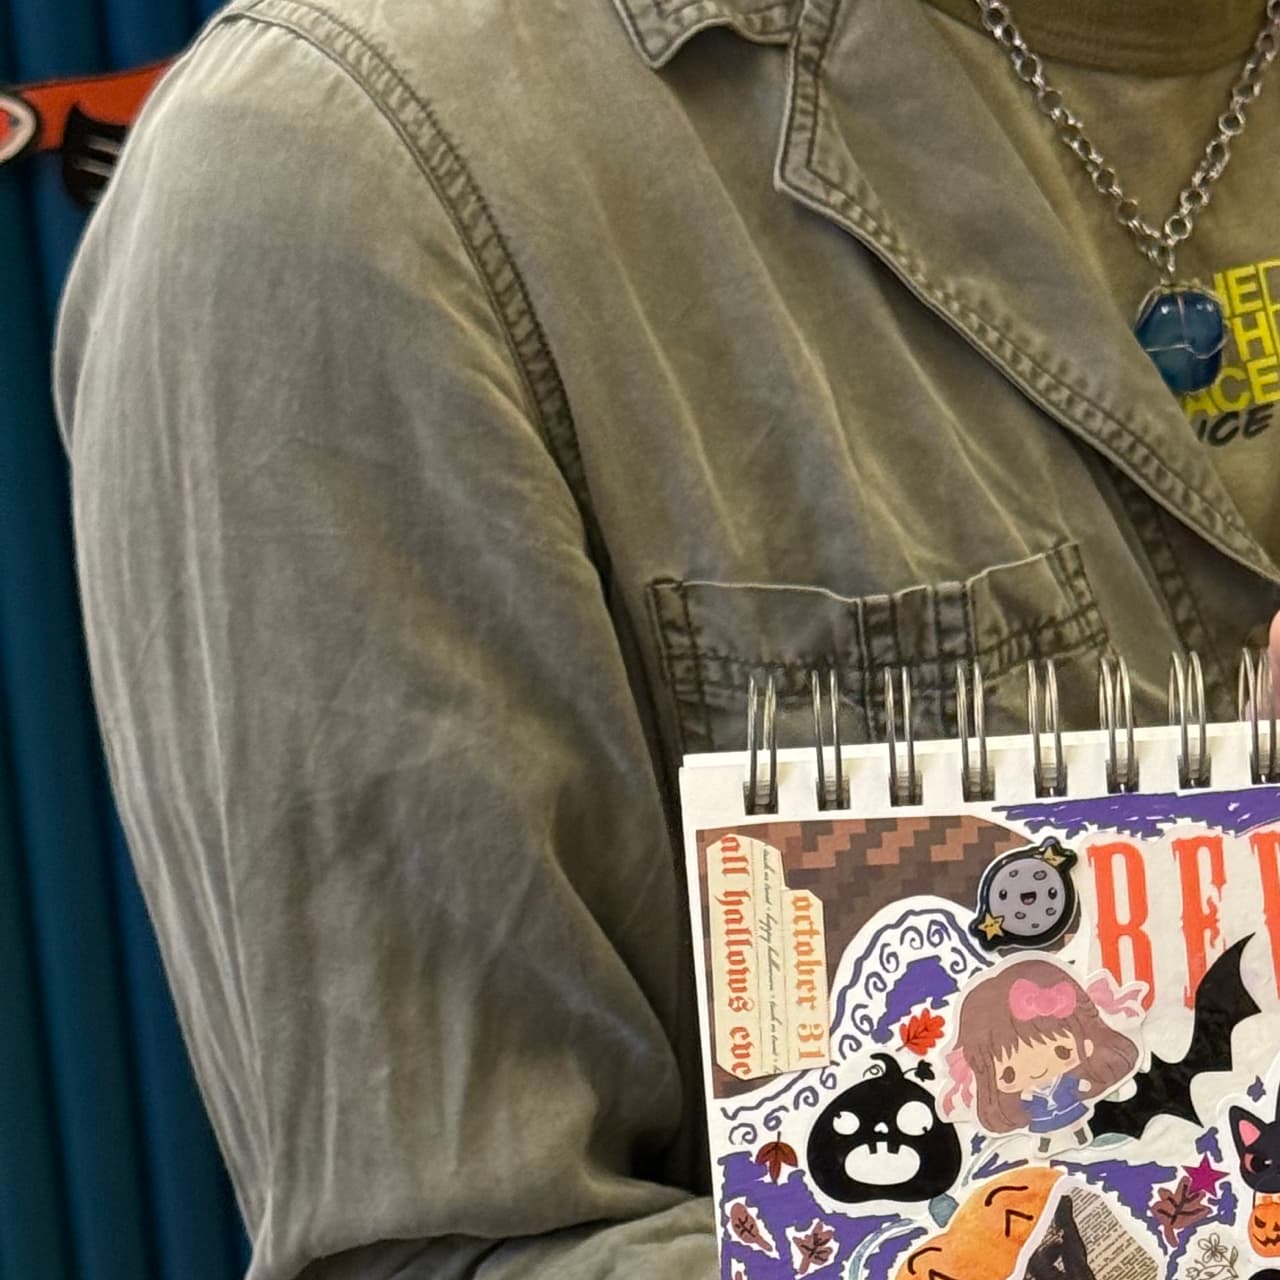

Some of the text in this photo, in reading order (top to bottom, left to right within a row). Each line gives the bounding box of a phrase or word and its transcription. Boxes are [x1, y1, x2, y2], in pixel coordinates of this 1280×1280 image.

[714, 836, 756, 1076] all hallows eve
[792, 895, 826, 1060] october 31
